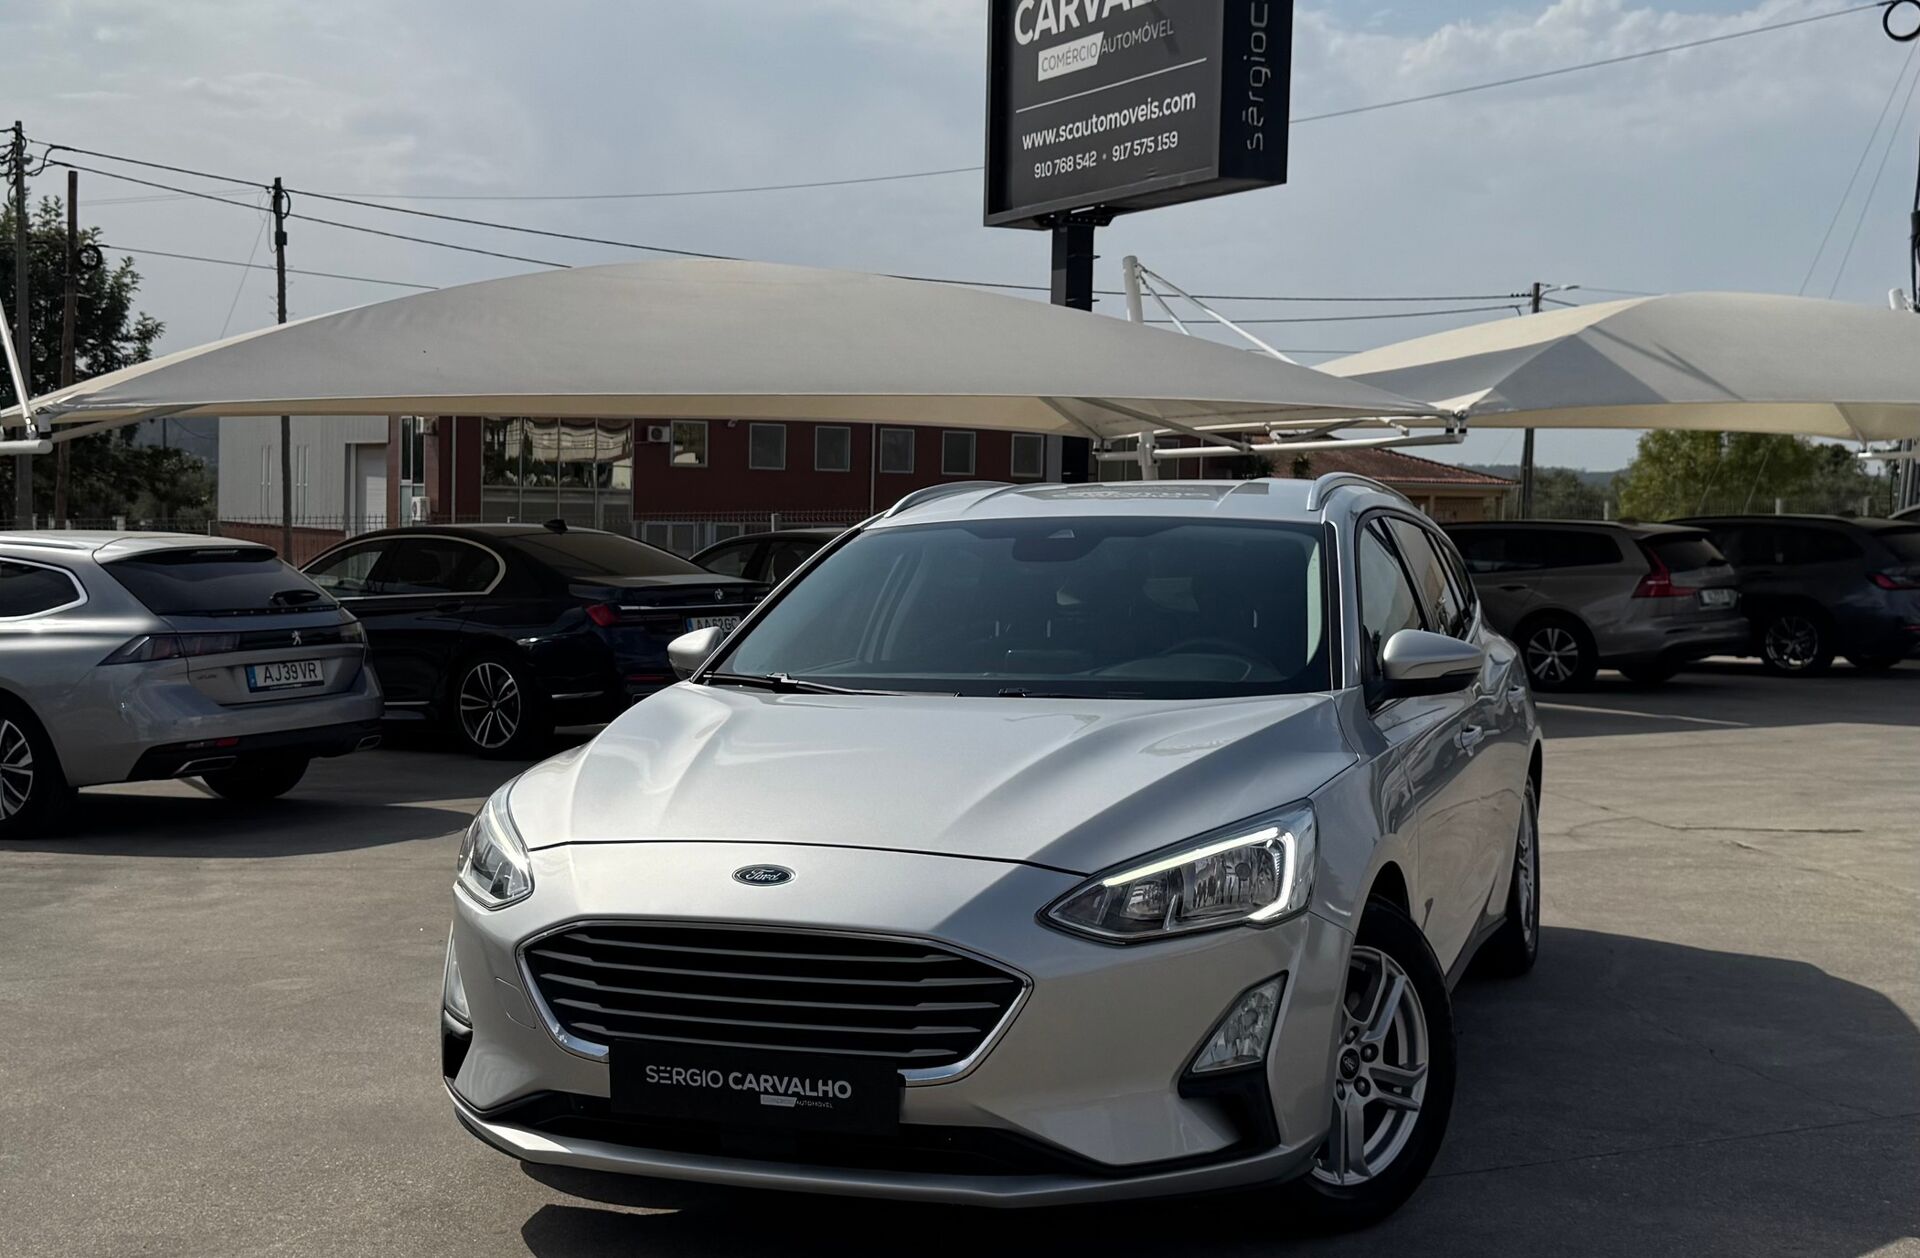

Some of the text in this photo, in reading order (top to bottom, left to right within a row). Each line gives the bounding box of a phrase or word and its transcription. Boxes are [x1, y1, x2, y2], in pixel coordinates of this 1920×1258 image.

[1041, 19, 1174, 72] COMÉRCIO AUTOMÓVEL
[1022, 91, 1196, 150] www.scautomoveis.com
[1034, 131, 1178, 178] 910 768 542 917 575 159
[745, 869, 782, 881] Ford
[728, 1072, 852, 1098] CARVALHO
